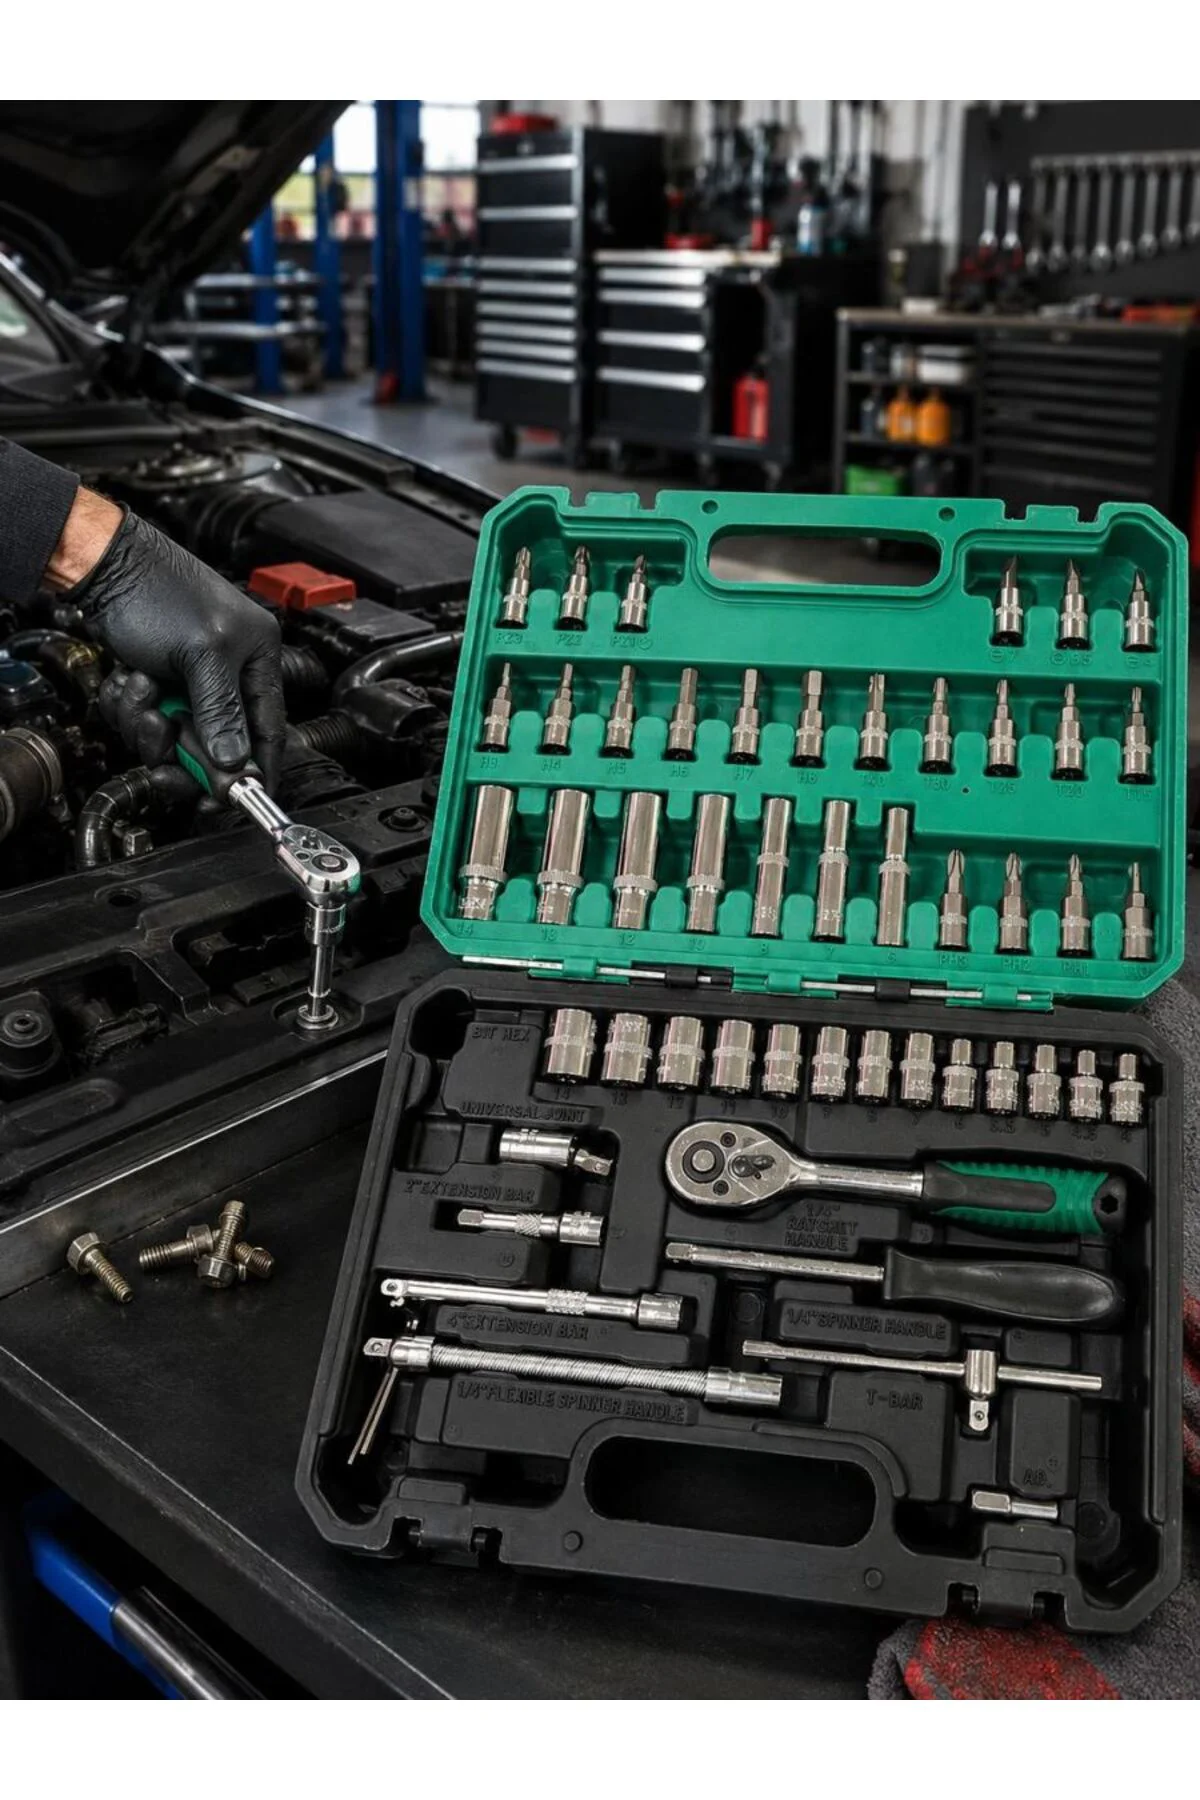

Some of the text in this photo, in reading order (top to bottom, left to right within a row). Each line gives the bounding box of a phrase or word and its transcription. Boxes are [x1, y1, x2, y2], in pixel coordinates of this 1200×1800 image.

[556, 634, 584, 647] PZ2
[606, 763, 627, 775] H5
[733, 767, 754, 781] H7
[618, 934, 635, 946] 12
[472, 1024, 530, 1042] BIT HEX
[458, 1100, 586, 1123] UNIVERSAL JOINT
[503, 1185, 535, 1203] BAR
[786, 1216, 859, 1236] RATCHET
[785, 1231, 849, 1252] HANDLE
[556, 1321, 588, 1341] BAR
[884, 1318, 946, 1340] HANDLE
[557, 1391, 622, 1415] SPINNER
[622, 1399, 685, 1422] HANDLE
[866, 1388, 923, 1411] T-BAR
